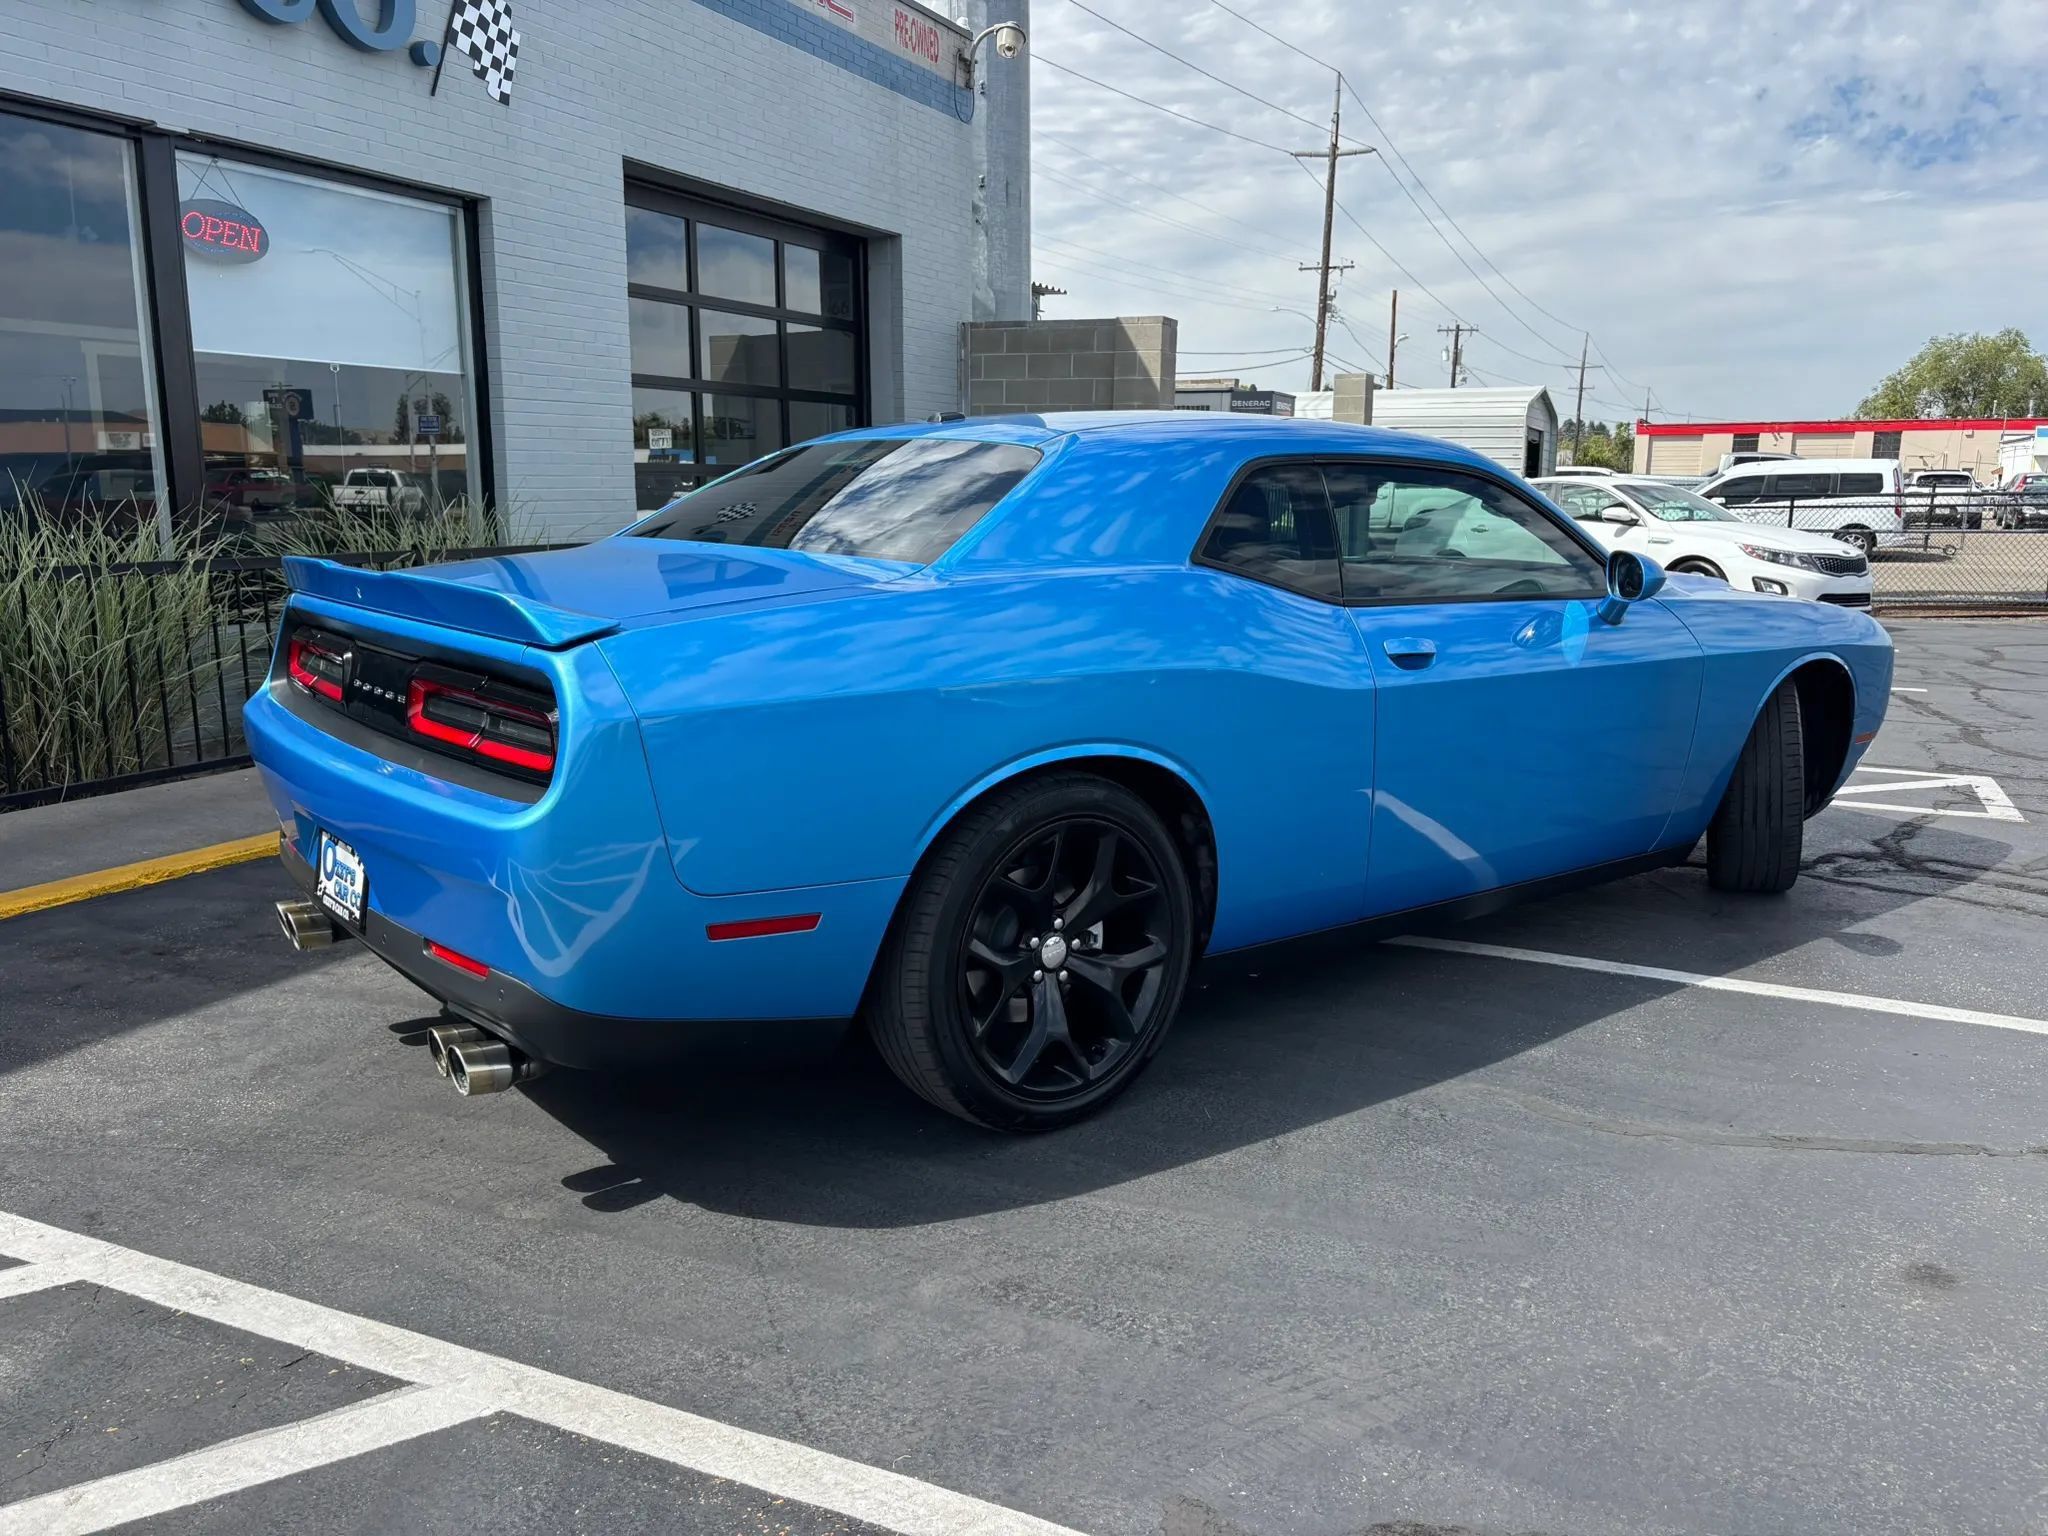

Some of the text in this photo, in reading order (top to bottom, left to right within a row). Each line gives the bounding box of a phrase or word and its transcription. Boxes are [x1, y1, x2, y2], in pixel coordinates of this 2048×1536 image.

[895, 9, 940, 63] PRE-OWNED
[181, 211, 262, 253] OPEN
[353, 678, 406, 704] DODGE
[334, 879, 349, 904] CAR
